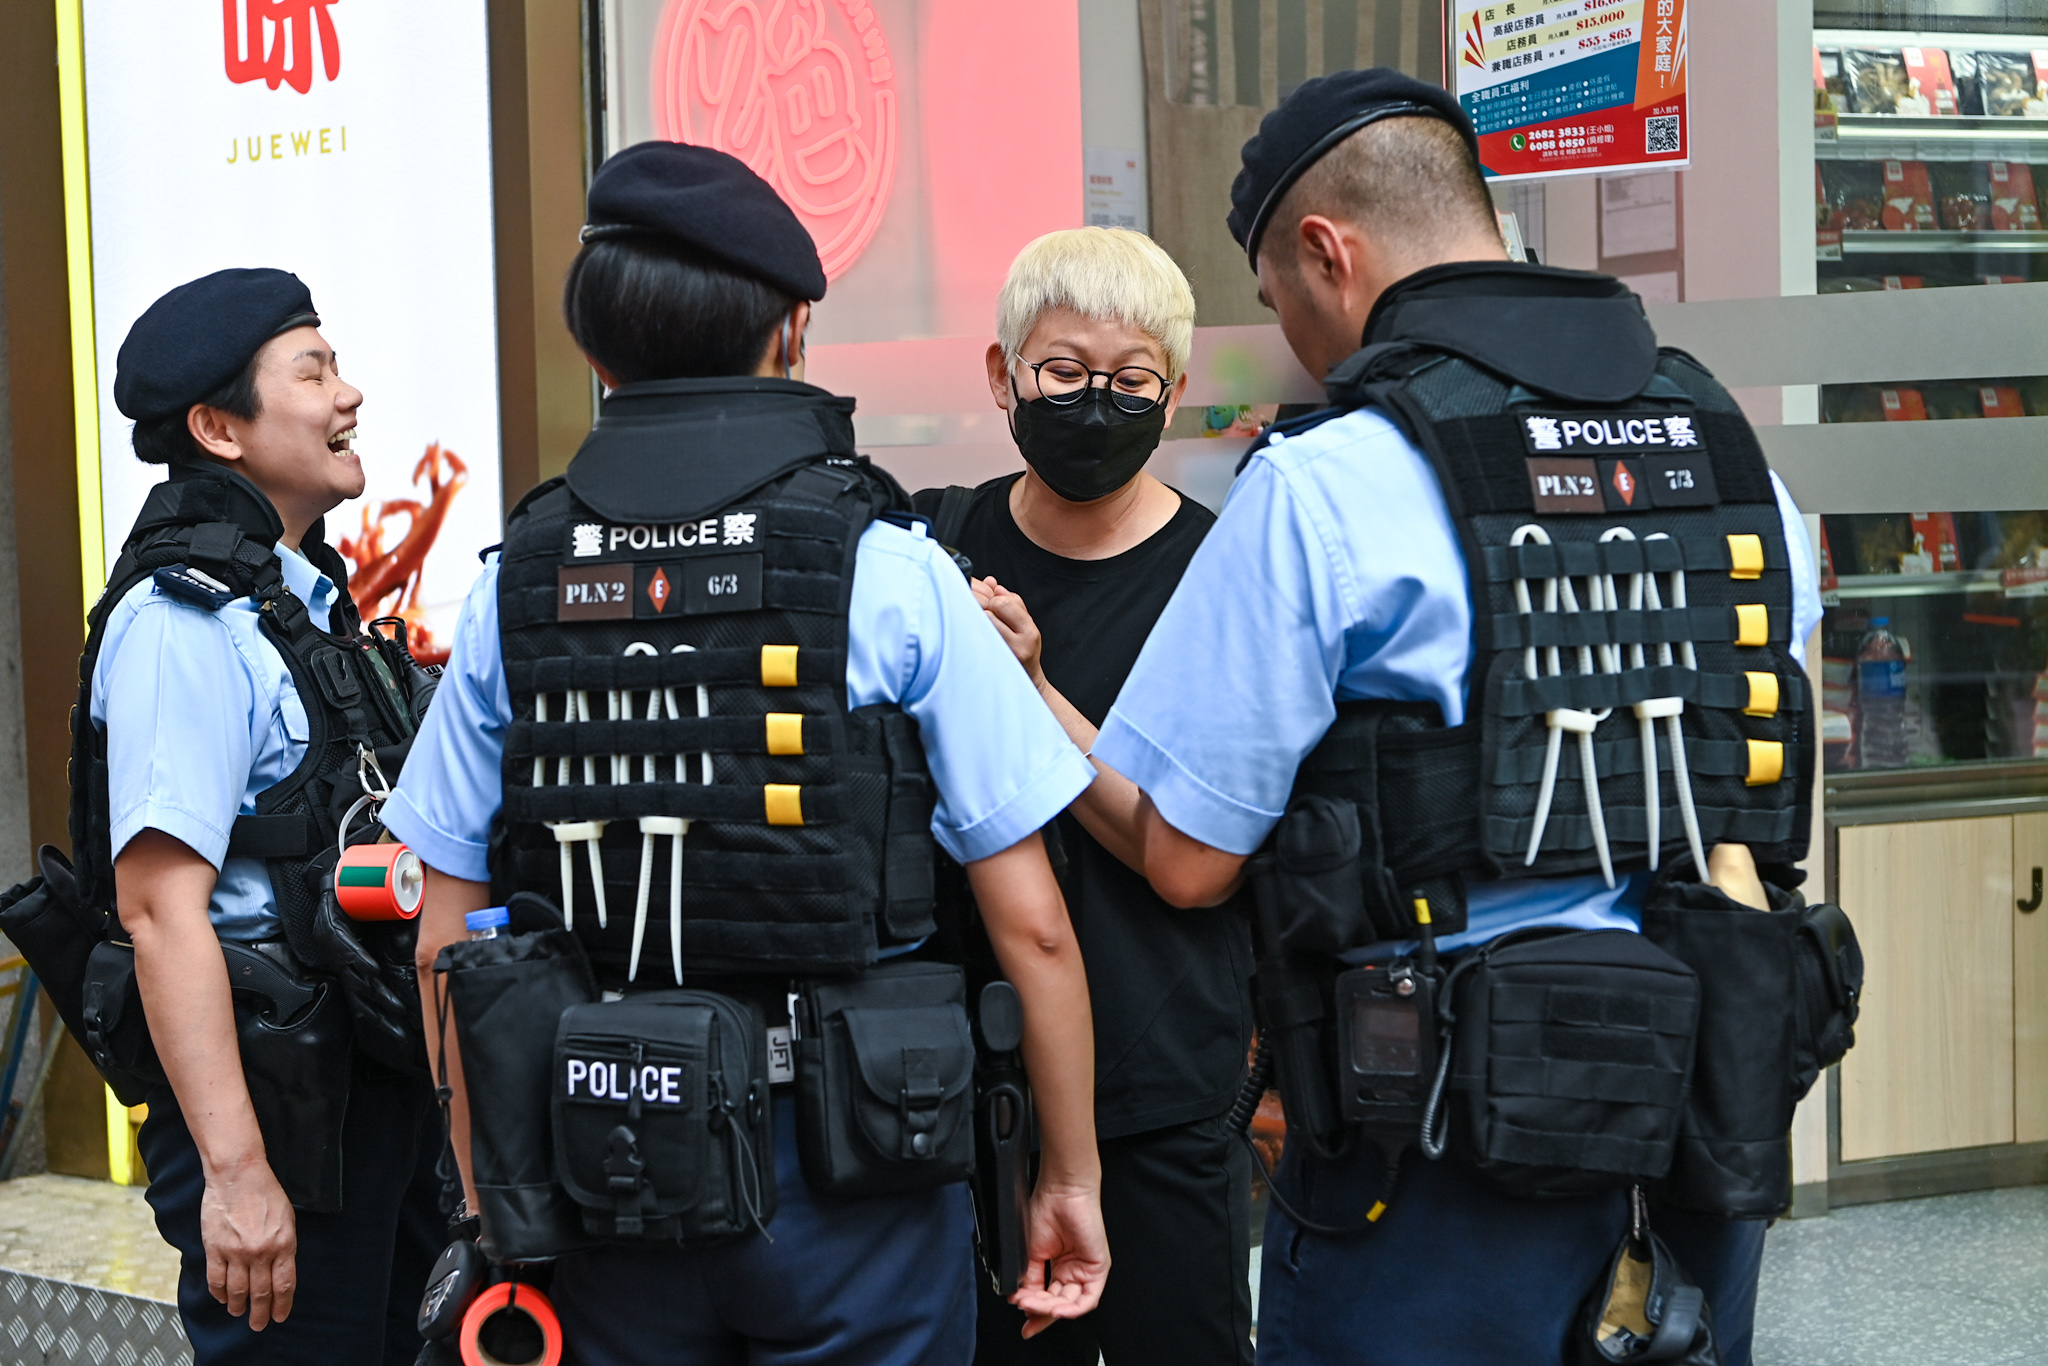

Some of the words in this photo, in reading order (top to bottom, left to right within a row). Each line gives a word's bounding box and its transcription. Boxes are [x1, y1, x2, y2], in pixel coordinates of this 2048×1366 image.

[1493, 13, 1545, 37] 高級店務員
[1506, 33, 1537, 51] 店務員
[1491, 50, 1543, 73] 兼職店務員
[1471, 79, 1530, 104] 全職員工福利
[1528, 129, 1555, 140] 2682
[1558, 126, 1586, 138] 3833
[1529, 140, 1556, 151] 6088
[1558, 138, 1585, 148] 6850
[227, 125, 346, 165] JUEWEI
[1561, 419, 1666, 446] POLICE
[1618, 472, 1630, 491] E
[572, 523, 604, 557] 警
[609, 518, 719, 551] POLICE
[722, 512, 757, 546] 察
[655, 579, 664, 599] E
[567, 1059, 681, 1104] POLICE
